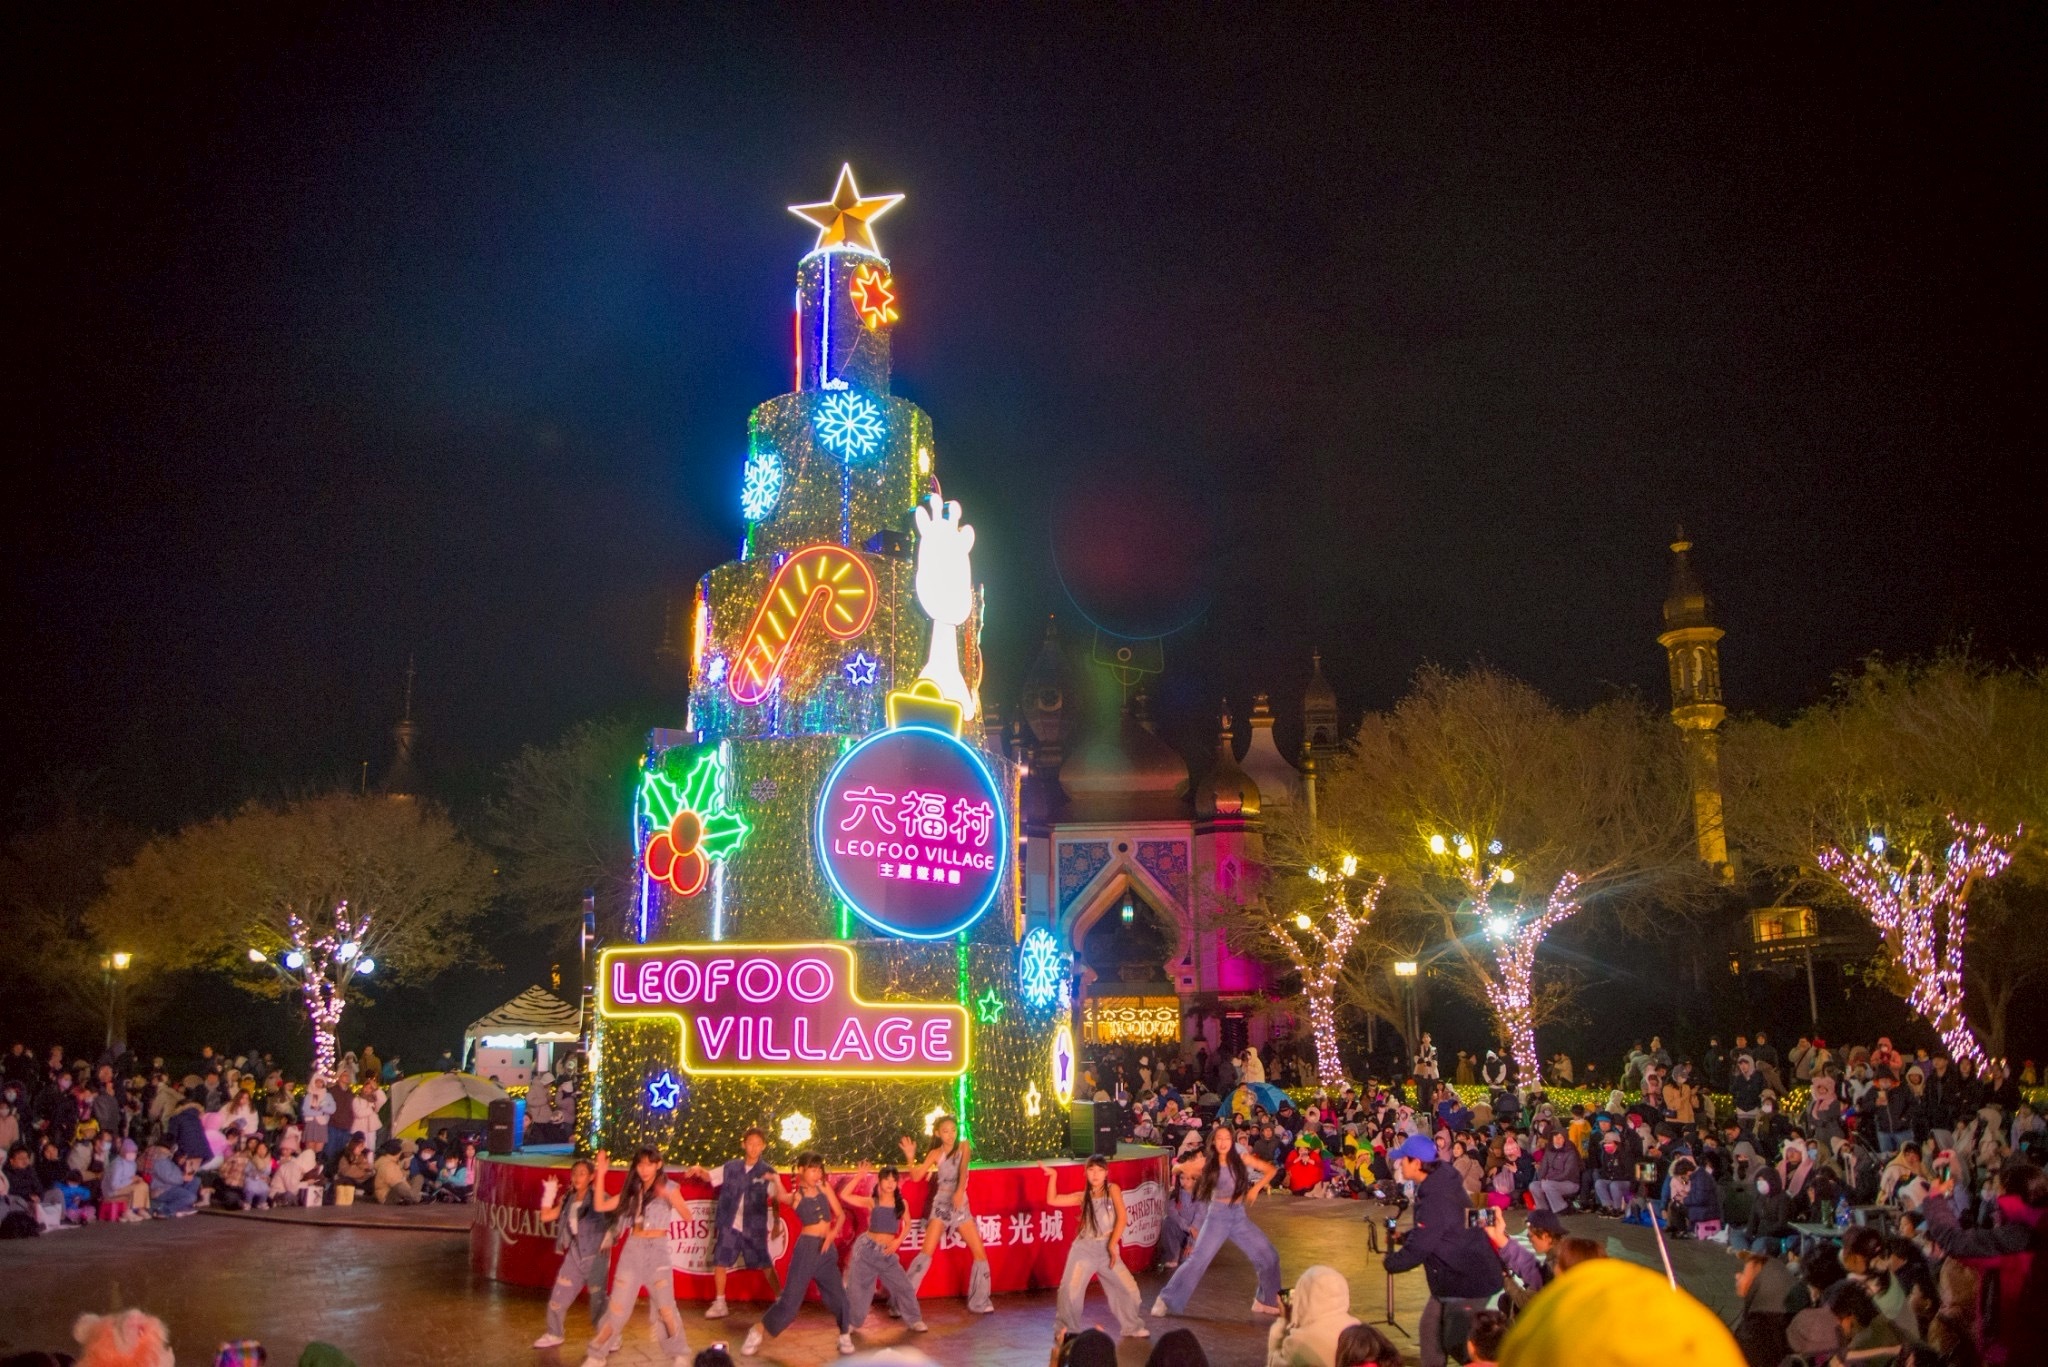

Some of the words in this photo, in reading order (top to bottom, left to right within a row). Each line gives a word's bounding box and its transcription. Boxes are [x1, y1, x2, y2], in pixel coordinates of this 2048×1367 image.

[840, 786, 994, 847] 六福村
[834, 839, 919, 861] LEOFOO
[925, 846, 995, 870] VILLAGE
[612, 958, 834, 1004] LEOFOO
[697, 1017, 953, 1062] VILLAGE
